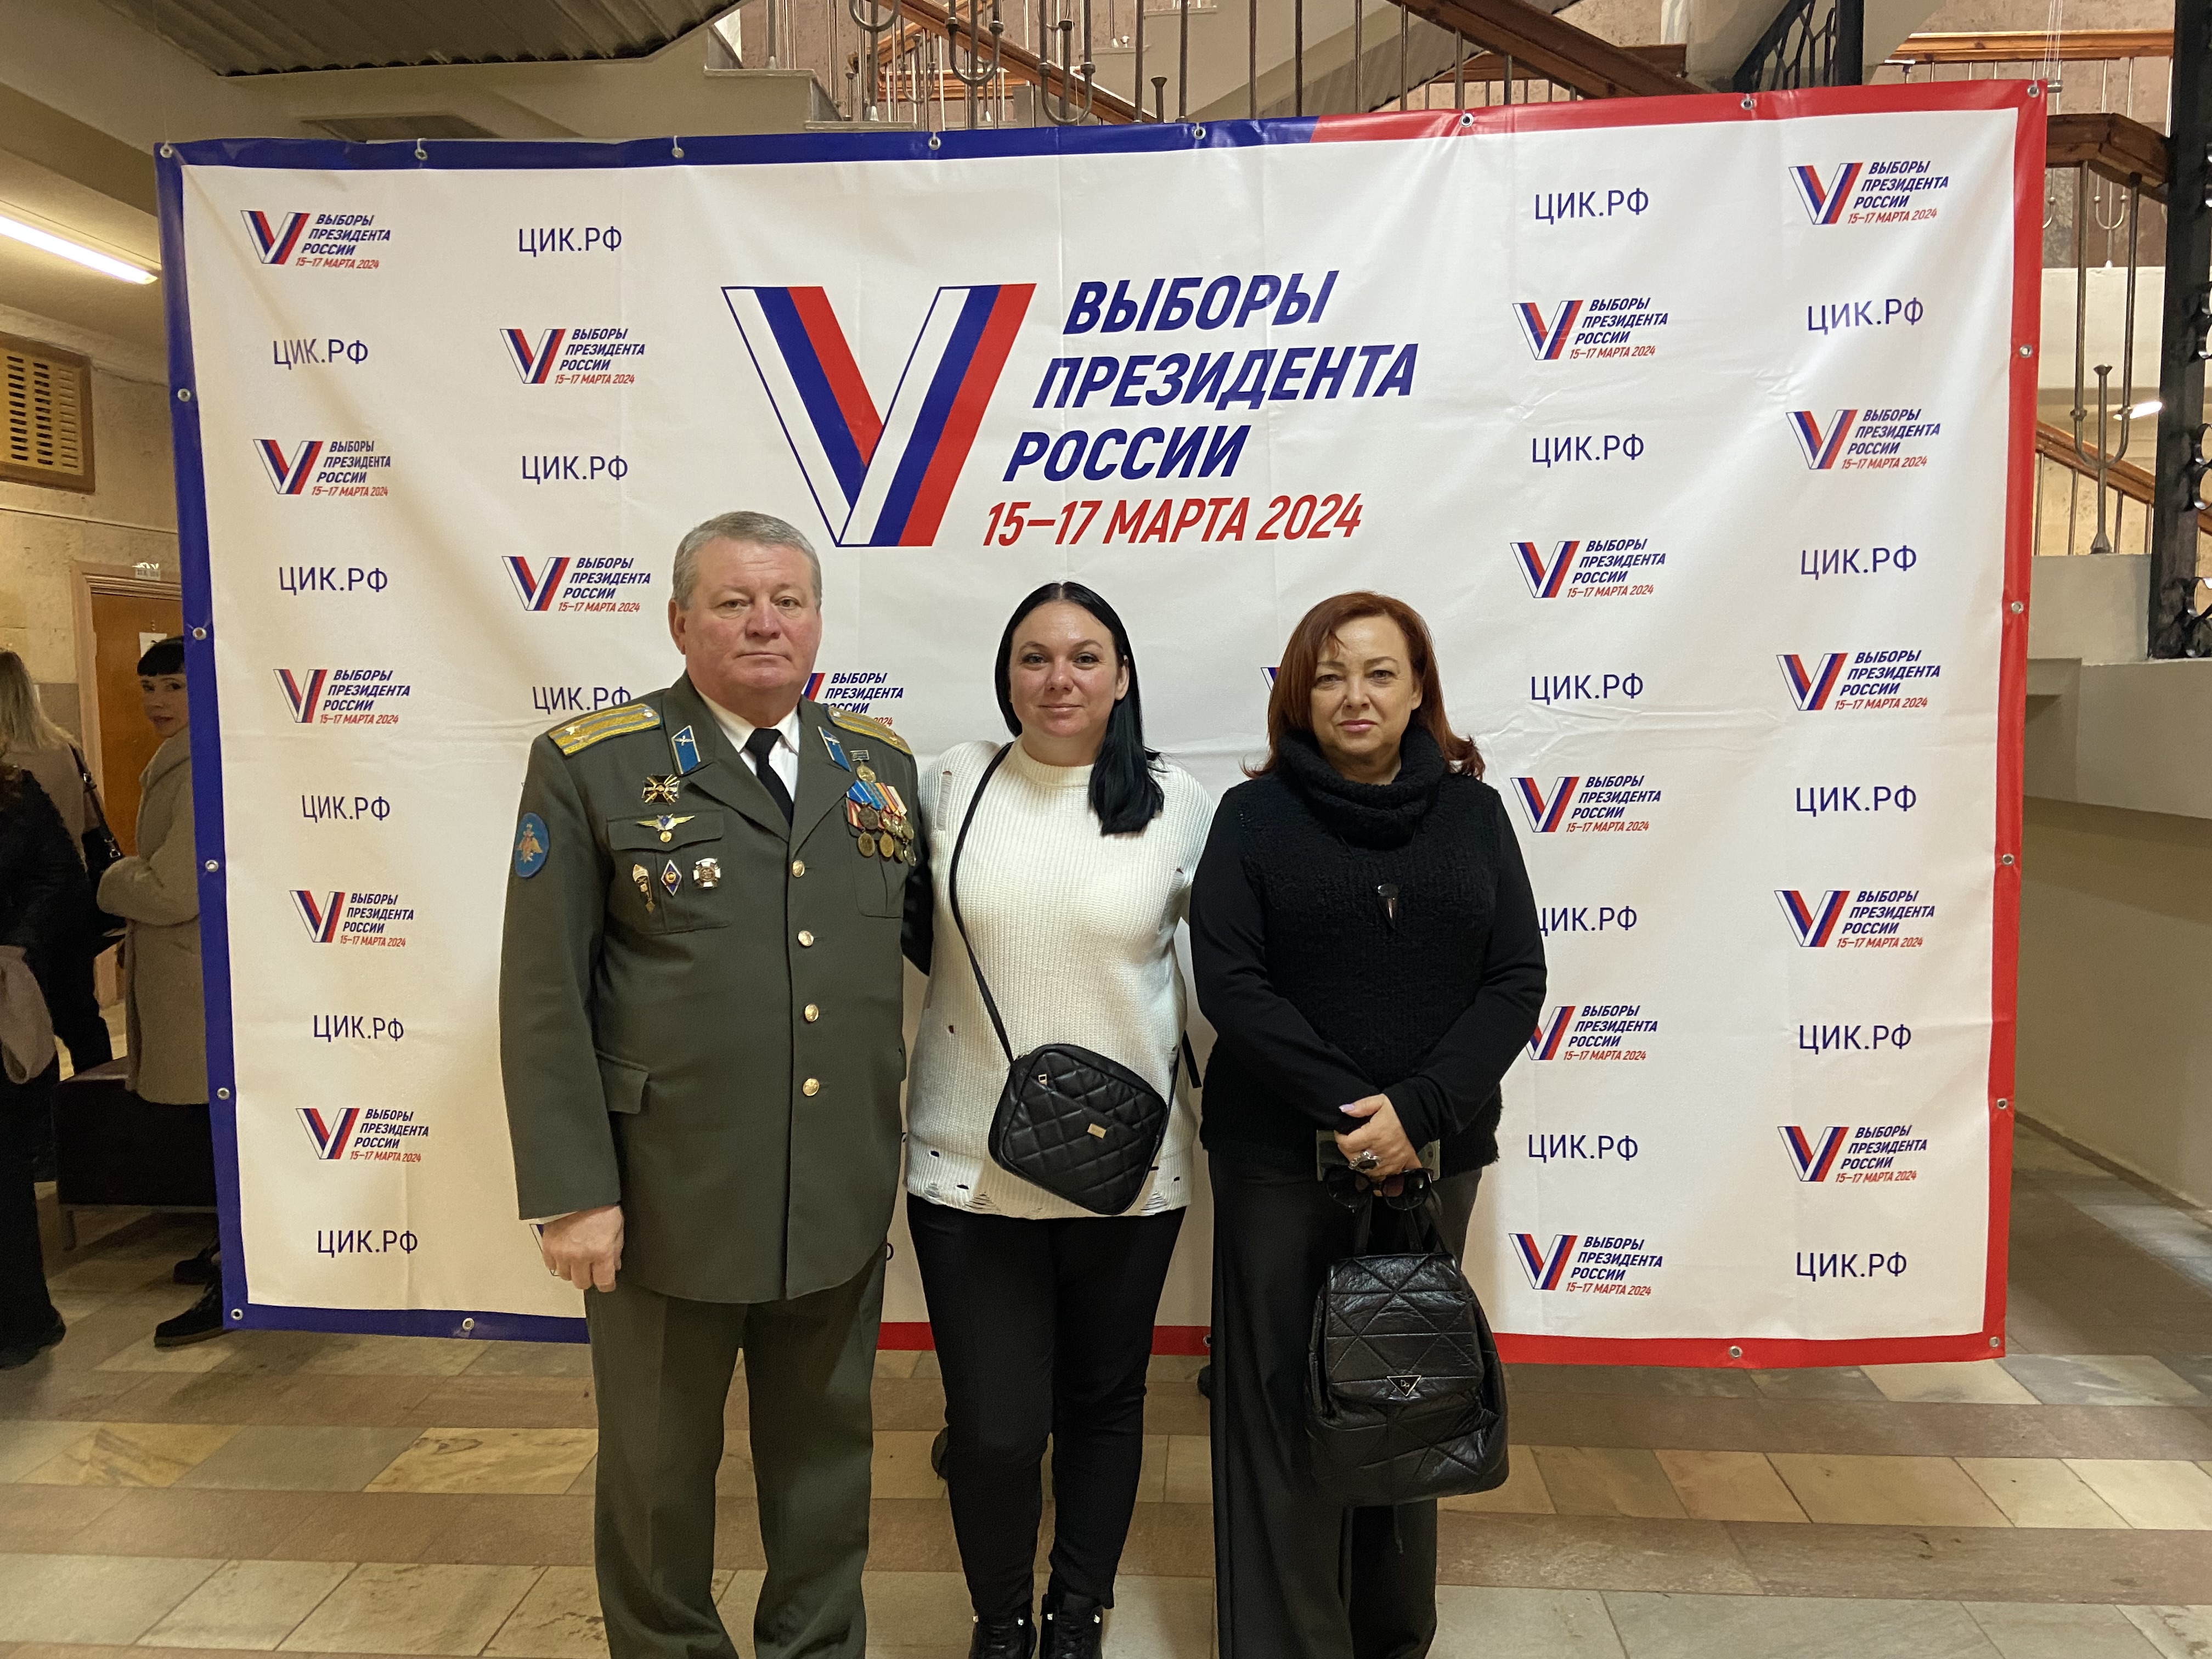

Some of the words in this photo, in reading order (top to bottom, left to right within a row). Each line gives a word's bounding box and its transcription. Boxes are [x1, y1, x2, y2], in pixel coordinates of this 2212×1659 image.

[1869, 161, 1931, 174] ВЫБОРЫ
[1861, 176, 1949, 193] ПРЕЗИДЕНТА
[1536, 188, 1648, 224] ЦИК.РФ
[1853, 195, 1910, 209] РОССИИ
[315, 214, 374, 226] ВЫБОРЫ
[1876, 211, 1910, 222] МАРТА
[1911, 208, 1937, 220] 2024
[308, 229, 391, 242] ПРЕЗИДЕНТА
[520, 226, 622, 257] ЦИК.РФ
[301, 243, 357, 256] РОССИИ
[323, 258, 356, 268] МАРТА
[357, 259, 379, 269] 2024
[1063, 270, 1339, 335] ВЫБОРЫ
[1589, 297, 1651, 311] ВЫБОРЫ
[1582, 313, 1668, 328] ПРЕЗИДЕНТА
[1808, 297, 1923, 335] ЦИК.РФ
[572, 328, 628, 340] ВЫБОРЫ
[1575, 331, 1630, 345] РОССИИ
[274, 338, 368, 370] ЦИК.РФ
[565, 344, 645, 357] ПРЕЗИДЕНТА
[1597, 347, 1630, 358] МАРТА
[1632, 346, 1655, 356] 2024
[559, 359, 611, 370] РОССИИ
[581, 374, 611, 383] МАРТА
[613, 374, 634, 383] 2024
[1032, 343, 1418, 410] ПРЕЗИДЕНТА
[1863, 409, 1921, 421] ВЫБОРЫ
[1855, 424, 1940, 439] ПРЕЗИДЕНТА
[329, 441, 374, 452] ВЫБОРЫ
[1533, 434, 1644, 468] ЦИК.РФ
[1847, 442, 1900, 455] РОССИИ
[1002, 425, 1251, 482] РОССИИ
[323, 456, 390, 469] ПРЕЗИДЕНТА
[1867, 458, 1900, 469] МАРТА
[1901, 456, 1927, 467] 2024
[522, 455, 628, 484] ЦИК.РФ
[317, 472, 367, 483] РОССИИ
[339, 487, 369, 496] МАРТА
[370, 487, 387, 496] 2024
[1103, 498, 1250, 544] МАРТА
[1255, 494, 1363, 540] 2024
[1586, 539, 1647, 552] ВЫБОРЫ
[576, 558, 634, 568] ВЫБОРЫ
[1579, 554, 1666, 568] ПРЕЗИДЕНТА
[1802, 545, 1916, 580] ЦИК.РФ
[279, 567, 387, 595] ЦИК.РФ
[570, 573, 651, 585] ПРЕЗИДЕНТА
[1572, 571, 1628, 584] РОССИИ
[563, 588, 616, 599] РОССИИ
[1594, 586, 1628, 596] МАРТА
[1629, 585, 1654, 595] 2024
[585, 602, 616, 612] МАРТА
[618, 603, 640, 612] 2024
[1854, 650, 1922, 664] ВЫБОРЫ
[333, 670, 393, 681] ВЫБОРЫ
[831, 673, 888, 684] ВЫБОРЫ
[1847, 665, 1940, 680] ПРЕЗИДЕНТА
[328, 684, 410, 698] ПРЕЗИДЕНТА
[825, 687, 904, 701] ПРЕЗИДЕНТА
[1532, 673, 1643, 705] ЦИК.РФ
[1839, 682, 1900, 696] РОССИИ
[323, 699, 374, 711] РОССИИ
[532, 686, 631, 715] ЦИК.РФ
[1865, 698, 1900, 709] МАРТА
[1902, 698, 1927, 708] 2024
[343, 714, 375, 724] МАРТА
[376, 715, 398, 724] 2024
[1585, 776, 1645, 787] ВЫБОРЫ
[1578, 791, 1661, 804] ПРЕЗИДЕНТА
[1797, 785, 1916, 817] ЦИК.РФ
[302, 795, 390, 823] ЦИК.РФ
[1571, 807, 1625, 819] РОССИИ
[1593, 822, 1624, 832] МАРТА
[1626, 821, 1649, 831] 2024
[351, 893, 398, 905] ВЫБОРЫ
[1857, 891, 1919, 902] ВЫБОРЫ
[347, 907, 414, 921] ПРЕЗИДЕНТА
[1849, 906, 1934, 919] ПРЕЗИДЕНТА
[342, 922, 385, 933] РОССИИ
[1842, 922, 1899, 934] РОССИИ
[361, 936, 386, 946] МАРТА
[387, 938, 405, 947] 2024
[1866, 938, 1899, 947] МАРТА
[1900, 938, 1922, 947] 2024
[1581, 1006, 1640, 1017] ВЫБОРЫ
[314, 1015, 403, 1042] ЦИК.РФ
[1575, 1020, 1657, 1033] ПРЕЗИДЕНТА
[1568, 1036, 1621, 1047] РОССИИ
[1800, 1024, 1911, 1054] ЦИК.РФ
[1589, 1051, 1622, 1060] МАРТА
[1623, 1051, 1646, 1060] 2024
[365, 1109, 414, 1121] ВЫБОРЫ
[360, 1123, 428, 1137] ПРЕЗИДЕНТА
[1855, 1125, 1912, 1138] ВЫБОРЫ
[354, 1137, 400, 1149] РОССИИ
[1529, 1135, 1638, 1163] ЦИК.РФ
[1848, 1139, 1927, 1154] ПРЕЗИДЕНТА
[374, 1152, 400, 1160] МАРТА
[402, 1153, 421, 1162] 2024
[1840, 1156, 1894, 1169] РОССИИ
[1863, 1172, 1894, 1182] МАРТА
[1895, 1171, 1916, 1181] 2024
[318, 1230, 417, 1258] ЦИК.РФ
[1583, 1237, 1644, 1250] ВЫБОРЫ
[1577, 1252, 1662, 1267] ПРЕЗИДЕНТА
[1571, 1267, 1626, 1280] РОССИИ
[1797, 1252, 1906, 1282] ЦИК.РФ
[1593, 1284, 1626, 1294] МАРТА
[1628, 1286, 1651, 1295] 2024
